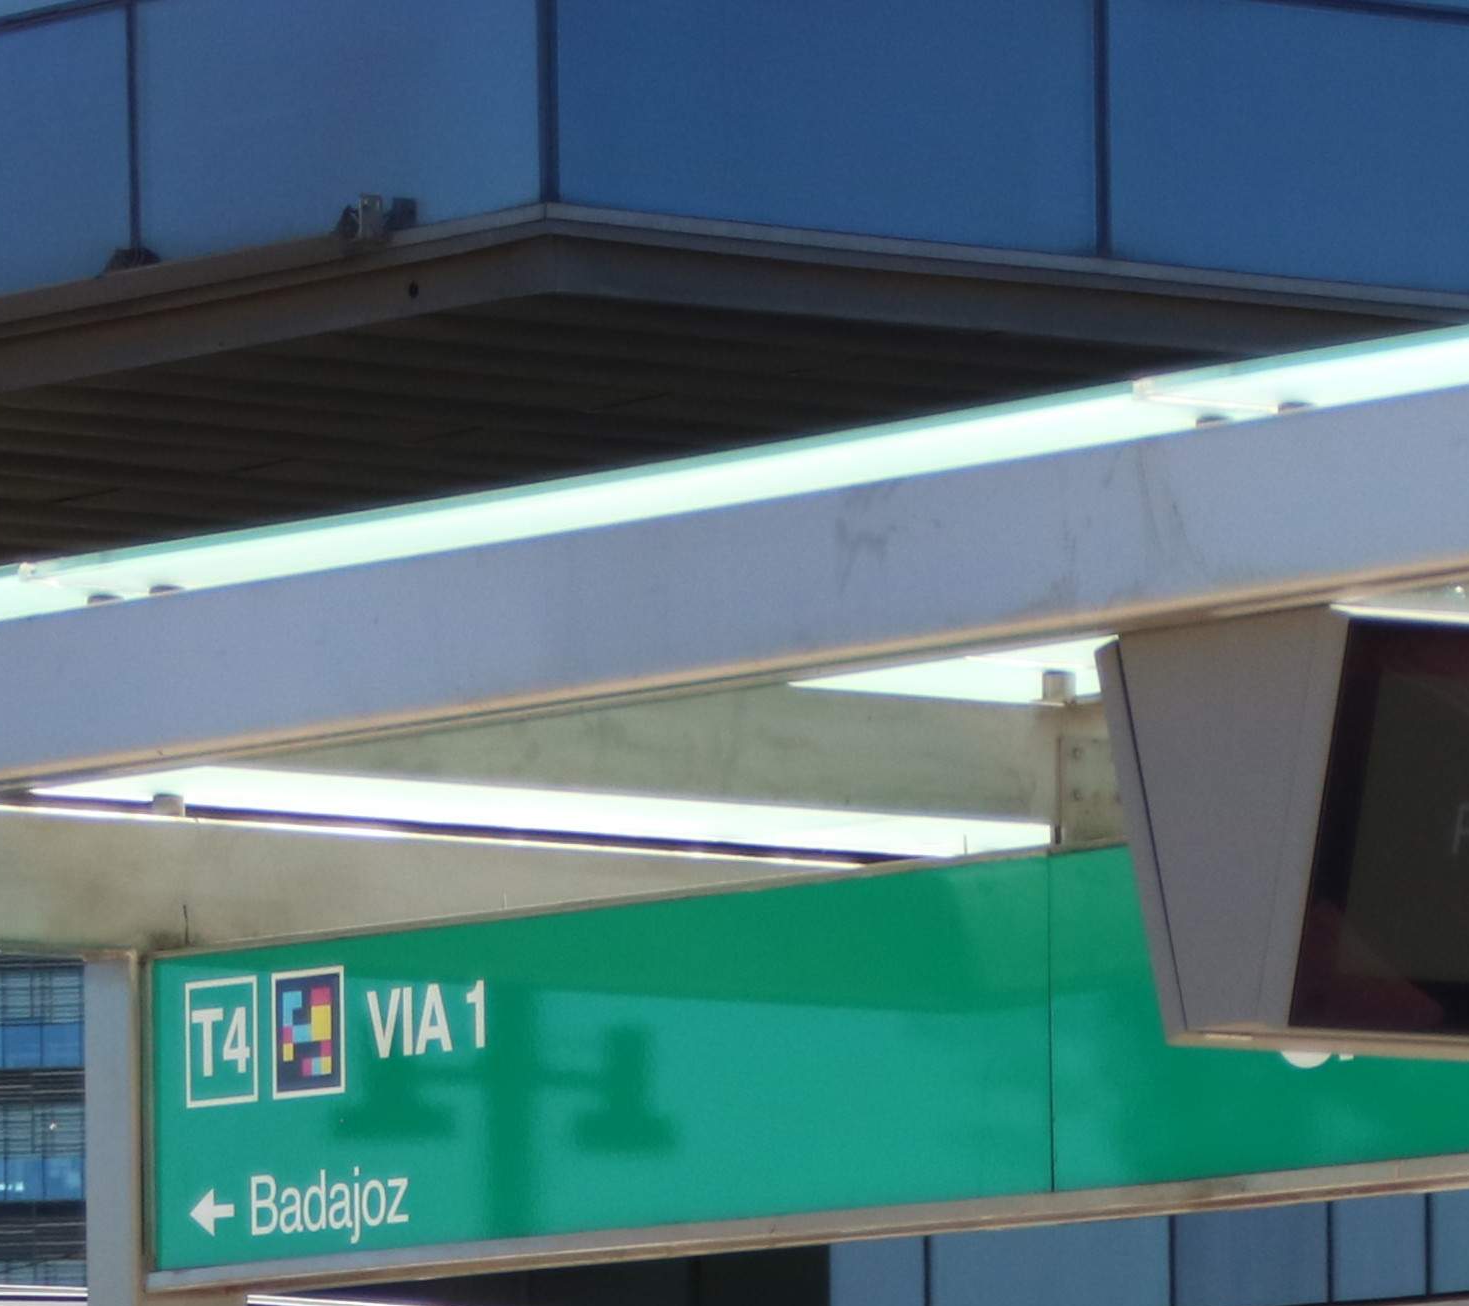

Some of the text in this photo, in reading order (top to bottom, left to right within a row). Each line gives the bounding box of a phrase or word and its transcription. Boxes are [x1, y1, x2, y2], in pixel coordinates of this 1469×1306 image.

[191, 1006, 251, 1077] T4
[366, 979, 485, 1058] VIA 1
[251, 1166, 409, 1244] Badajoz
